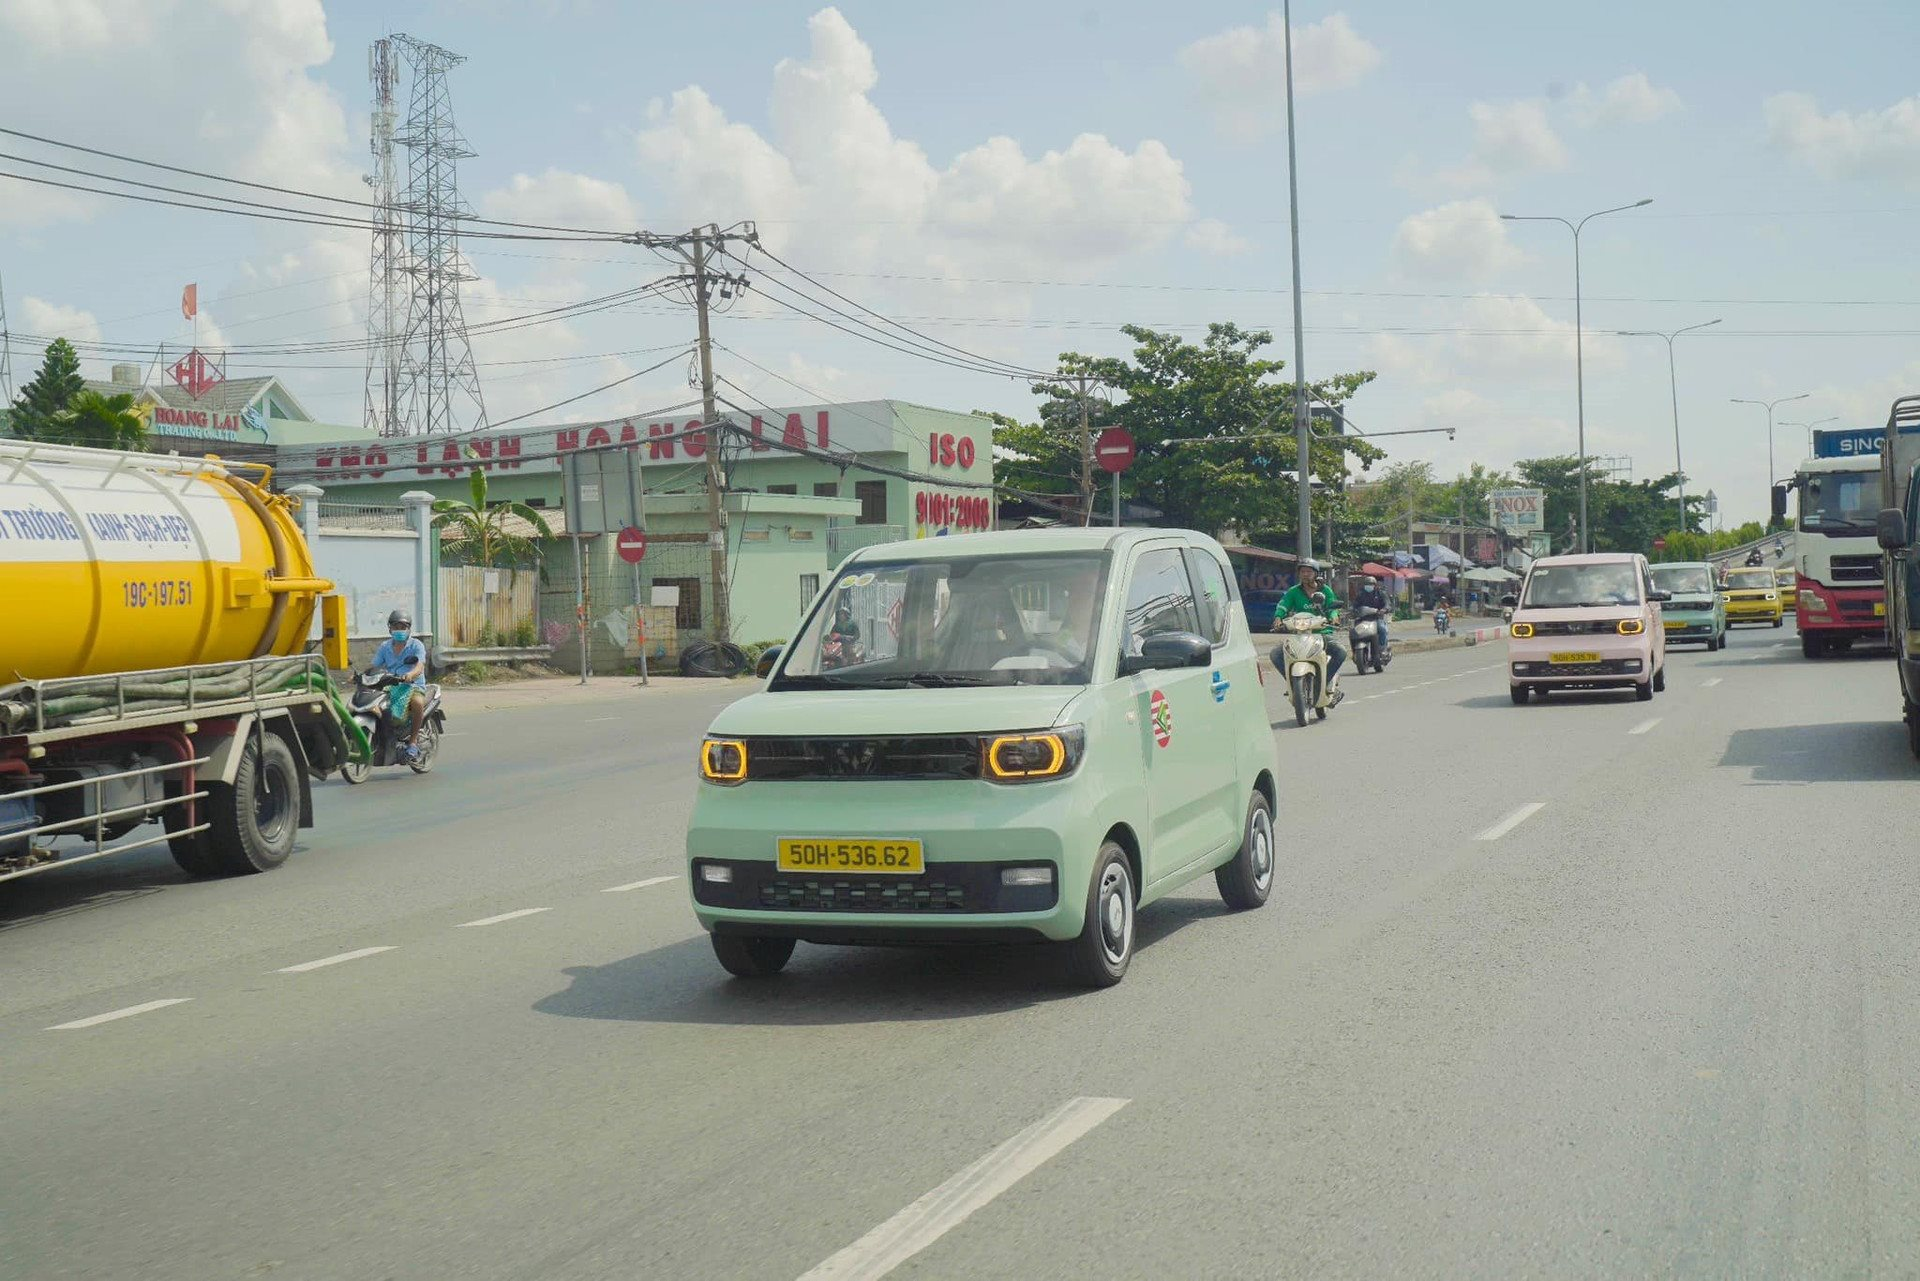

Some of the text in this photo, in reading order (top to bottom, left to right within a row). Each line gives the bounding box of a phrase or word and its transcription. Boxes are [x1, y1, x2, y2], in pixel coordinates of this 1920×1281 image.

[213, 413, 240, 431] LAI
[751, 411, 830, 452] LAI
[930, 432, 975, 469] ISO
[123, 581, 192, 608] 19C-197.51
[790, 844, 910, 867] 50H-536.62
